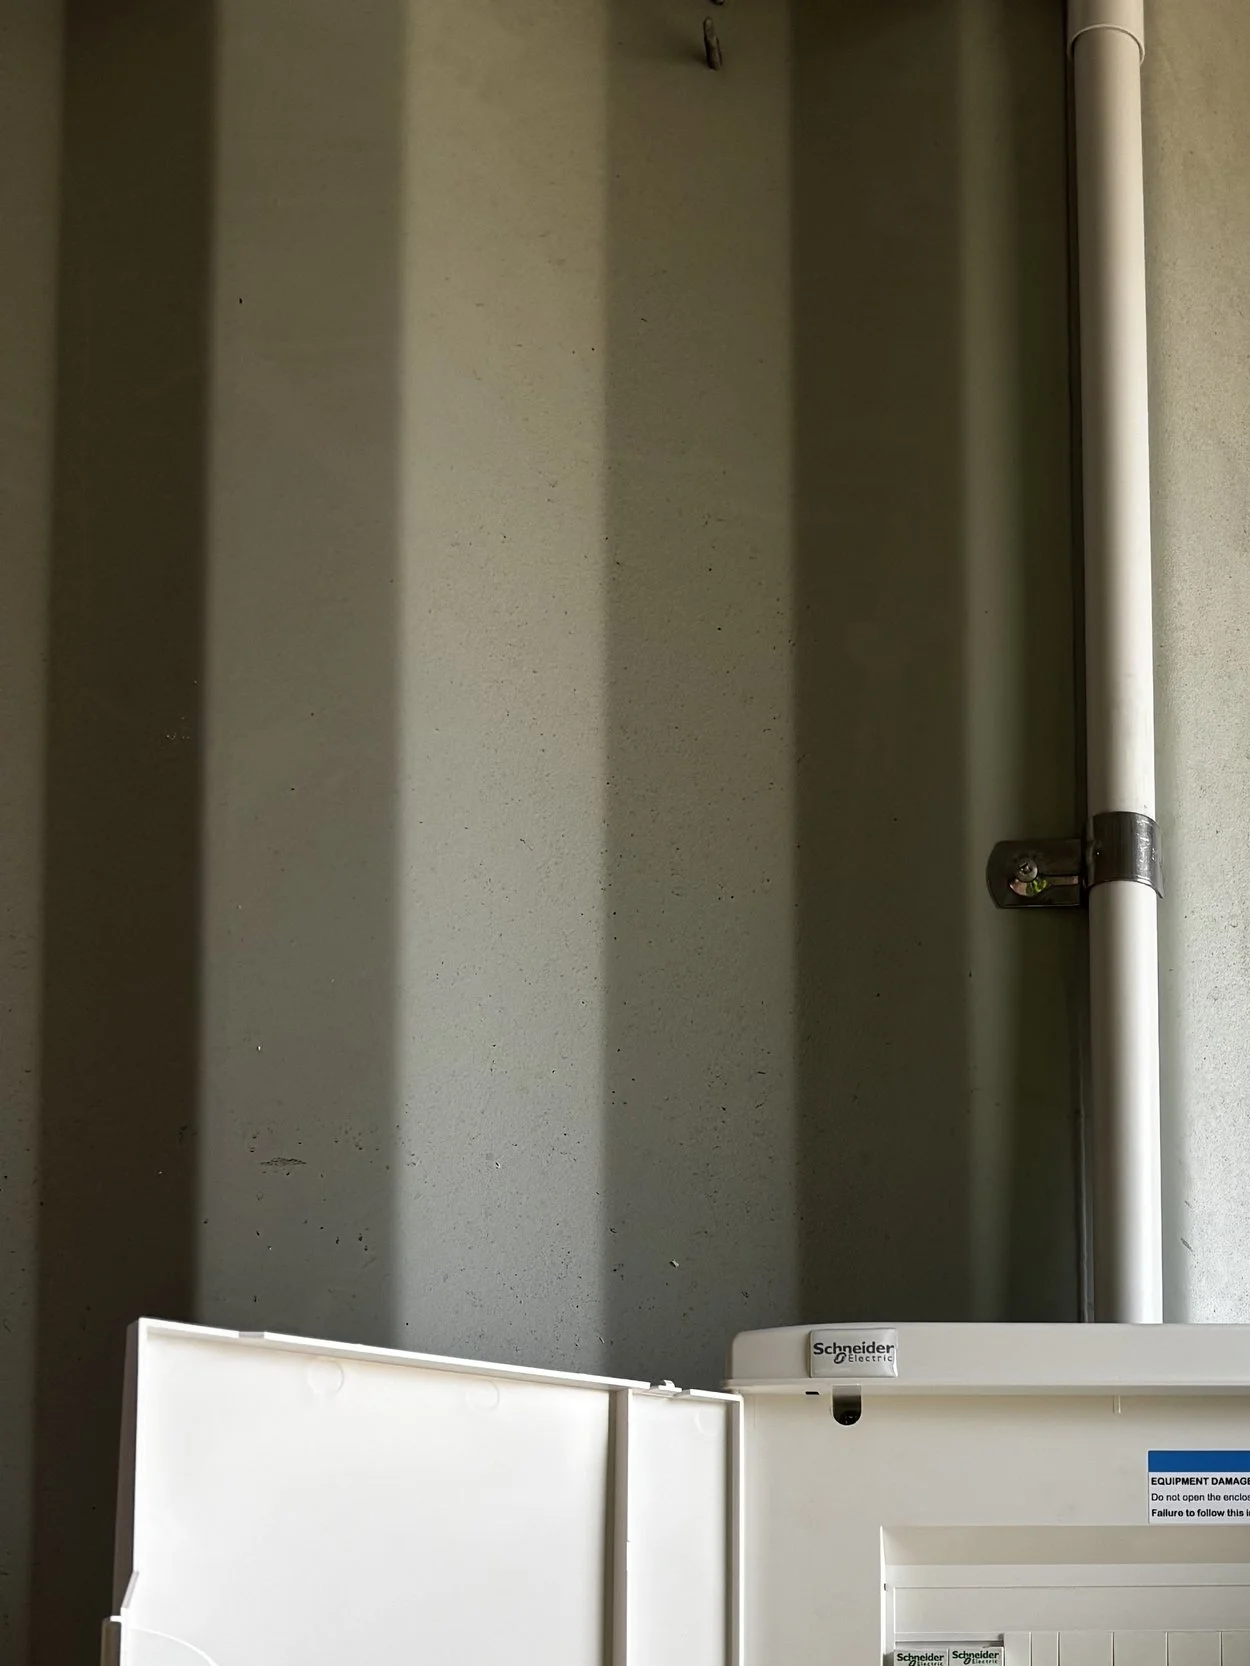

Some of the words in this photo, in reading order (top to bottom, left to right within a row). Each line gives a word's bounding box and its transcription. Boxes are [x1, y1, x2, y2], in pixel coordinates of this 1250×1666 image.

[813, 1340, 894, 1359] Schneider
[848, 1354, 894, 1362] Electric
[1151, 1477, 1209, 1486] EQUIPMENT
[1151, 1493, 1164, 1501] Do
[1207, 1493, 1221, 1501] the
[1152, 1509, 1184, 1517] Failure
[1186, 1509, 1196, 1517] to
[1197, 1509, 1225, 1517] follow
[1227, 1509, 1244, 1517] this
[896, 1652, 944, 1664] Schneider
[952, 1650, 1000, 1662] Schneider
